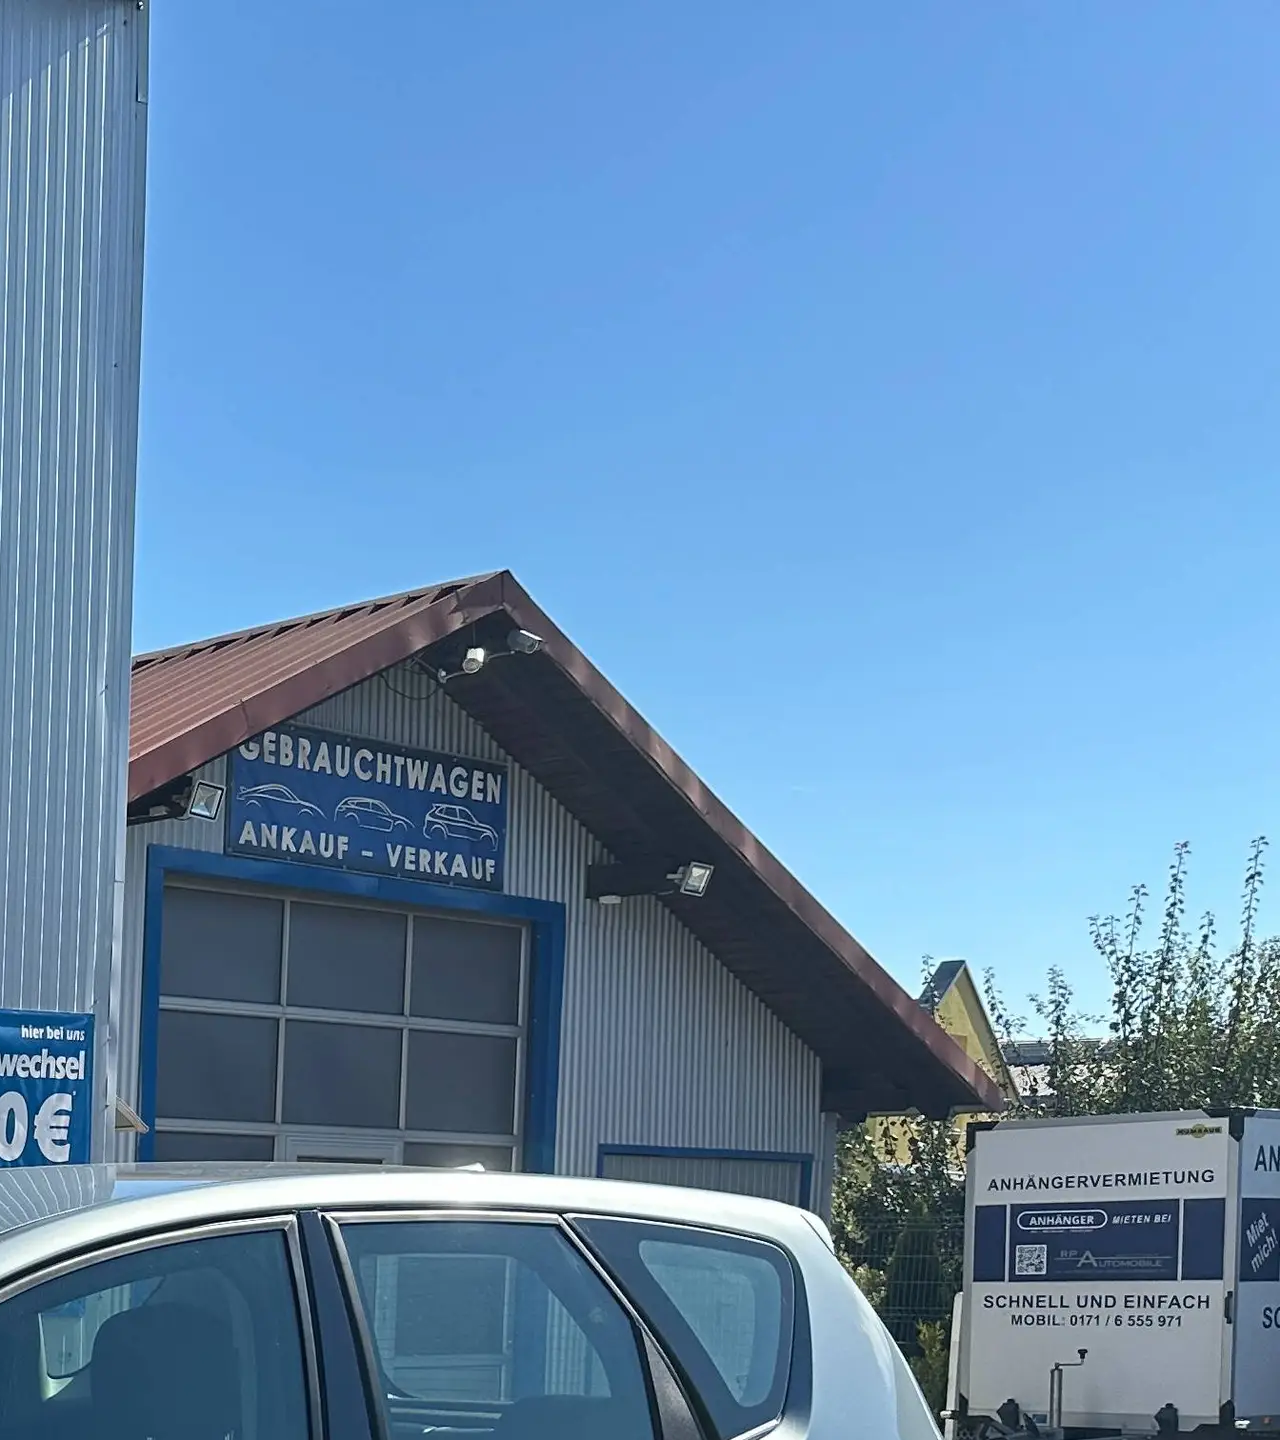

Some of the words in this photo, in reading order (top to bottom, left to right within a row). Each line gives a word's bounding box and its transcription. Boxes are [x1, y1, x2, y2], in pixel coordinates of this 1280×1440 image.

[239, 731, 501, 804] GEBRAUCHTWAGEN
[239, 821, 349, 860] ANKAUF
[386, 843, 496, 882] VERKAUF
[22, 1025, 44, 1039] hier
[46, 1026, 63, 1040] bei
[66, 1029, 85, 1041] uns
[987, 1170, 1214, 1191] ANHÄNGERVERMIETUNG
[1029, 1214, 1094, 1226] ANHÄNGER
[1112, 1215, 1150, 1224] MIETEN
[1154, 1214, 1172, 1223] BEI
[1245, 1211, 1270, 1248] Miet
[1250, 1228, 1279, 1273] mich!
[983, 1295, 1069, 1309] SCHNELL
[1076, 1295, 1116, 1309] UND
[1124, 1294, 1210, 1309] EINFACH
[1011, 1315, 1065, 1327] MOBIL:
[1069, 1315, 1100, 1327] 0171
[1114, 1316, 1122, 1327] 6
[1127, 1315, 1153, 1327] 555
[1157, 1316, 1182, 1327] 971
